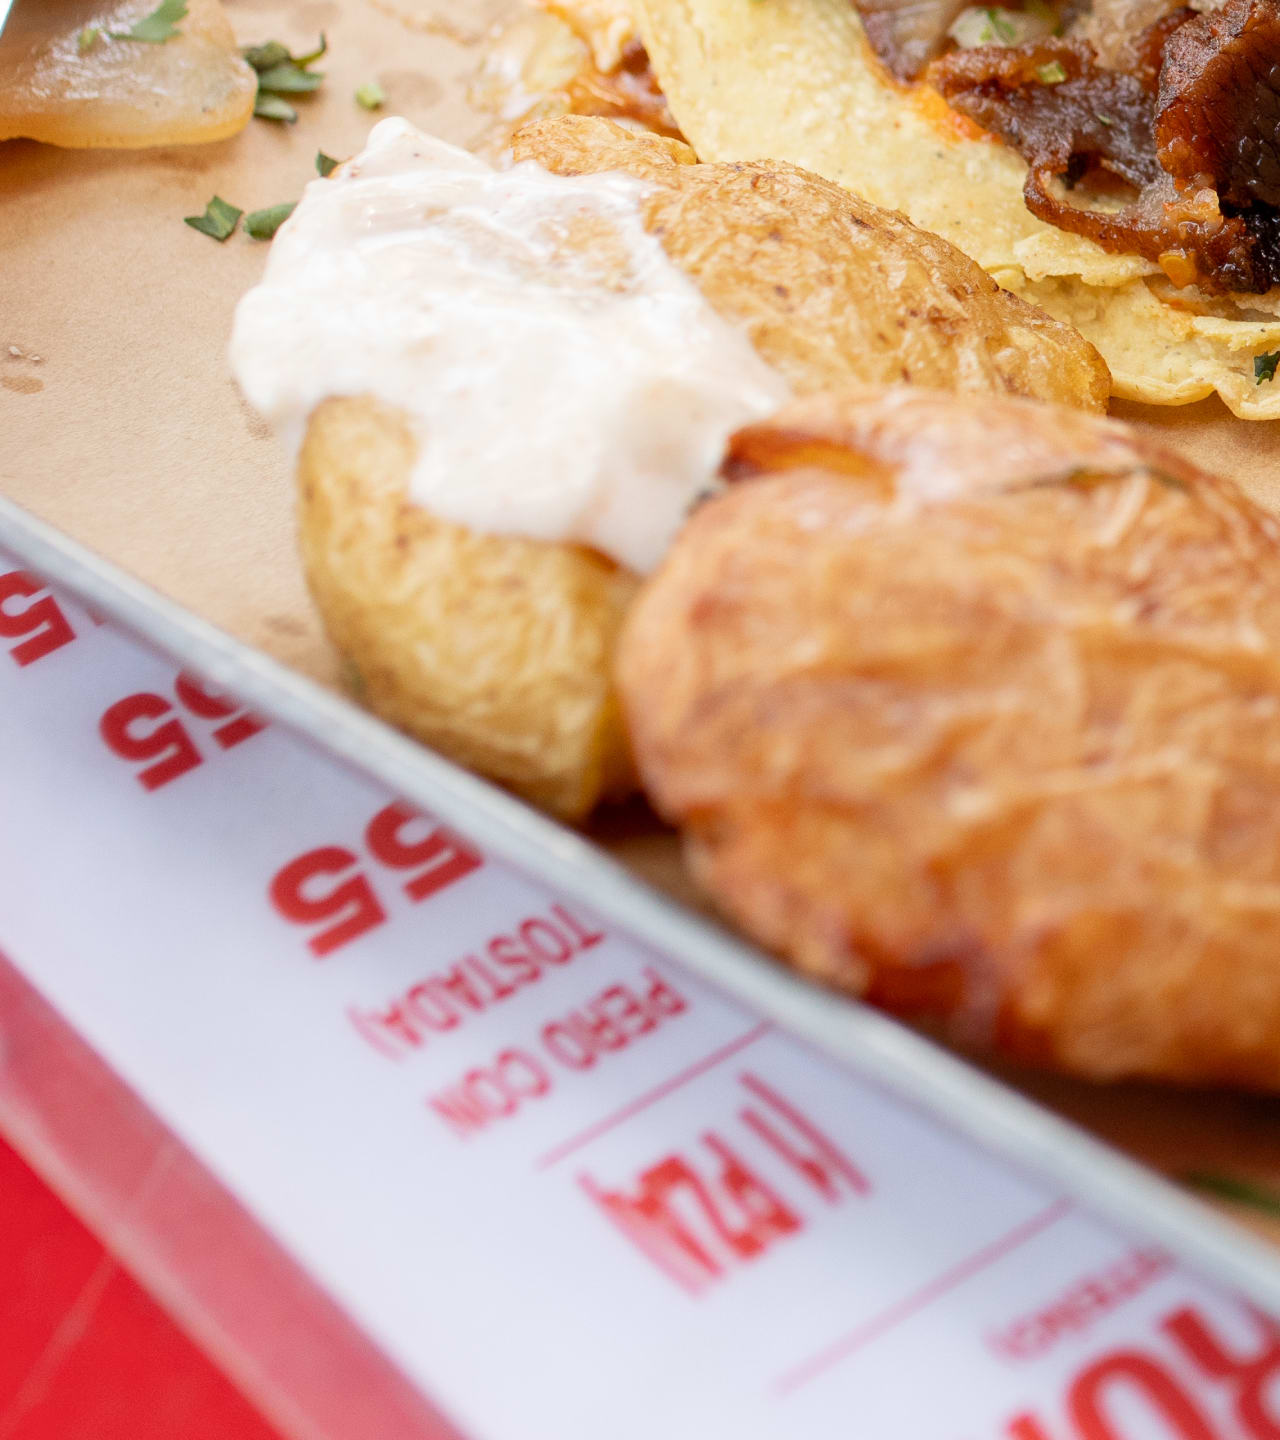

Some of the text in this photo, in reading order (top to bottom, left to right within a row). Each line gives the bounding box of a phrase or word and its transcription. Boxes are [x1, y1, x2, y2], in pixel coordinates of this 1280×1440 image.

[268, 801, 486, 959] 55
[345, 901, 606, 1063] TOSTADA)
[427, 967, 689, 1142] PERO CON
